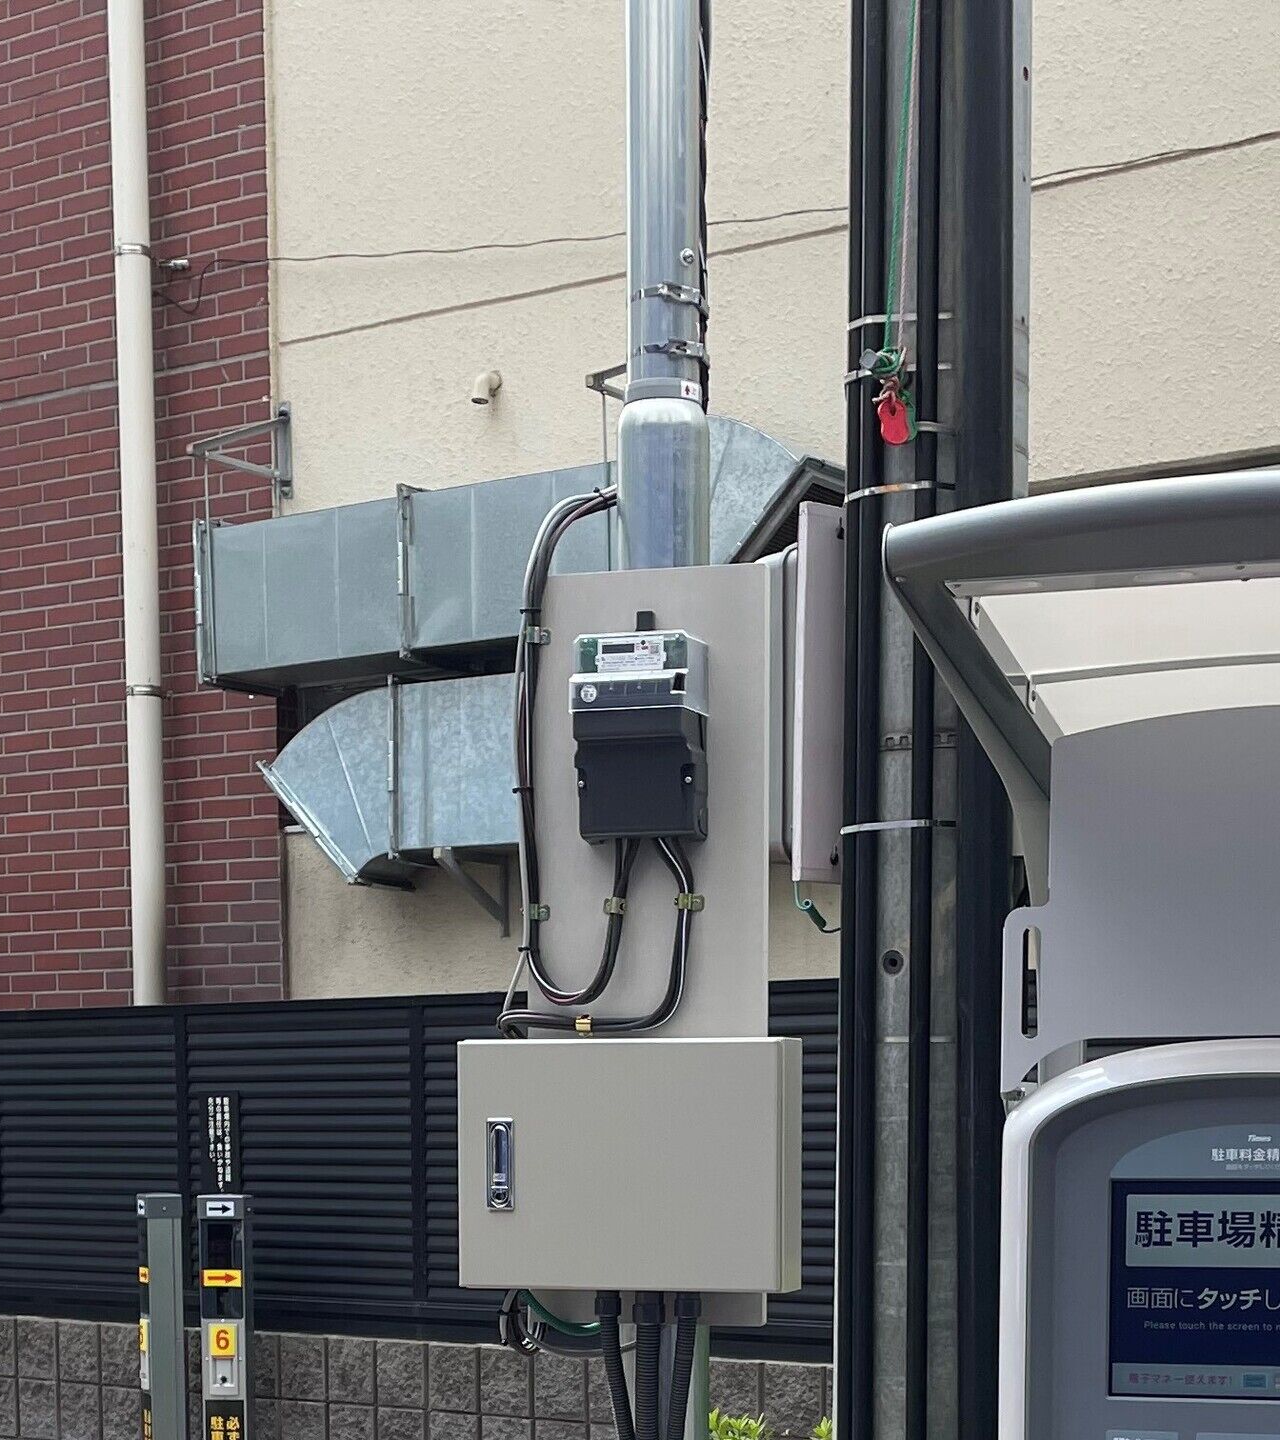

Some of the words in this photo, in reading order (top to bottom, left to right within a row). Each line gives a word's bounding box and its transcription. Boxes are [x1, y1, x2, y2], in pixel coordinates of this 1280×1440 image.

[1143, 1320, 1175, 1329] Please
[1178, 1320, 1207, 1330] touch
[1209, 1320, 1224, 1330] the
[1226, 1322, 1259, 1331] screen
[1262, 1322, 1272, 1331] to
[215, 1328, 231, 1350] 6
